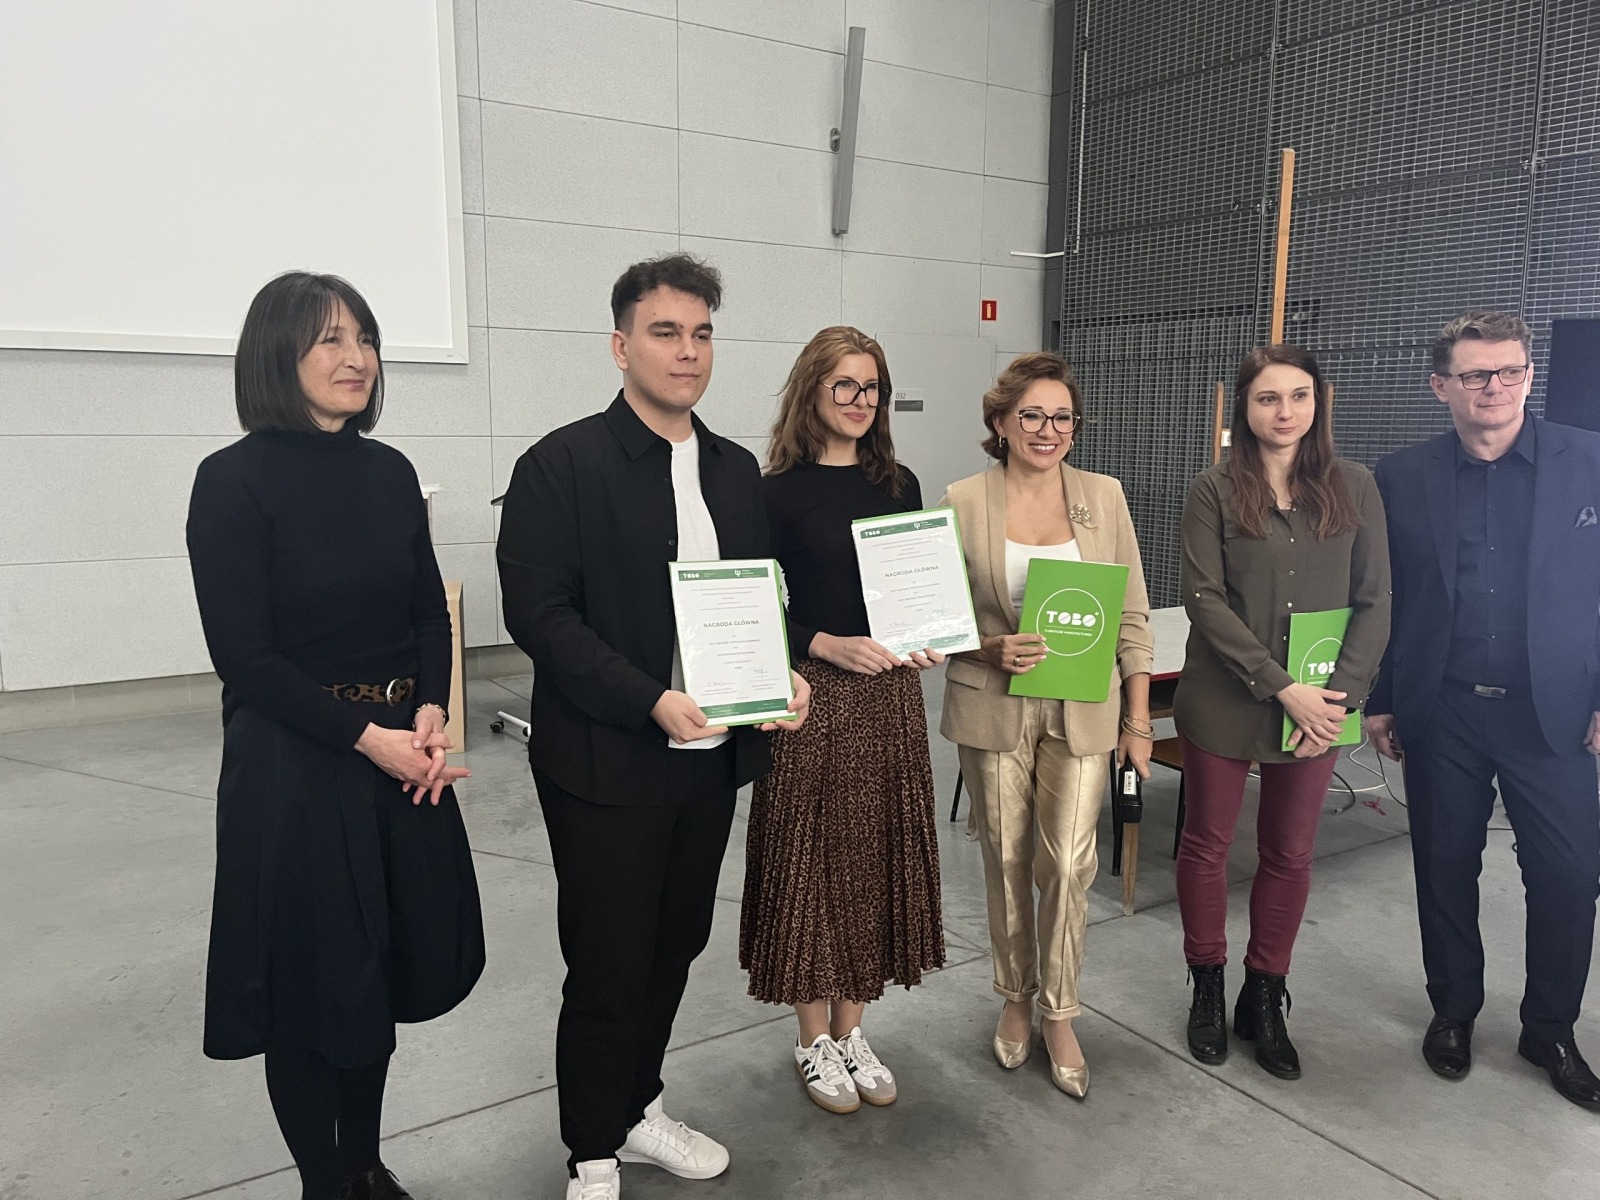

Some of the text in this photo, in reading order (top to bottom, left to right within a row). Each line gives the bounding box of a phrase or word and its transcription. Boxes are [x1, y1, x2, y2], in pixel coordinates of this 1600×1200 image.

[885, 565, 939, 578] NAGRODA GŁÓWNA
[1046, 610, 1096, 627] TOBO
[1307, 661, 1336, 676] TOB
